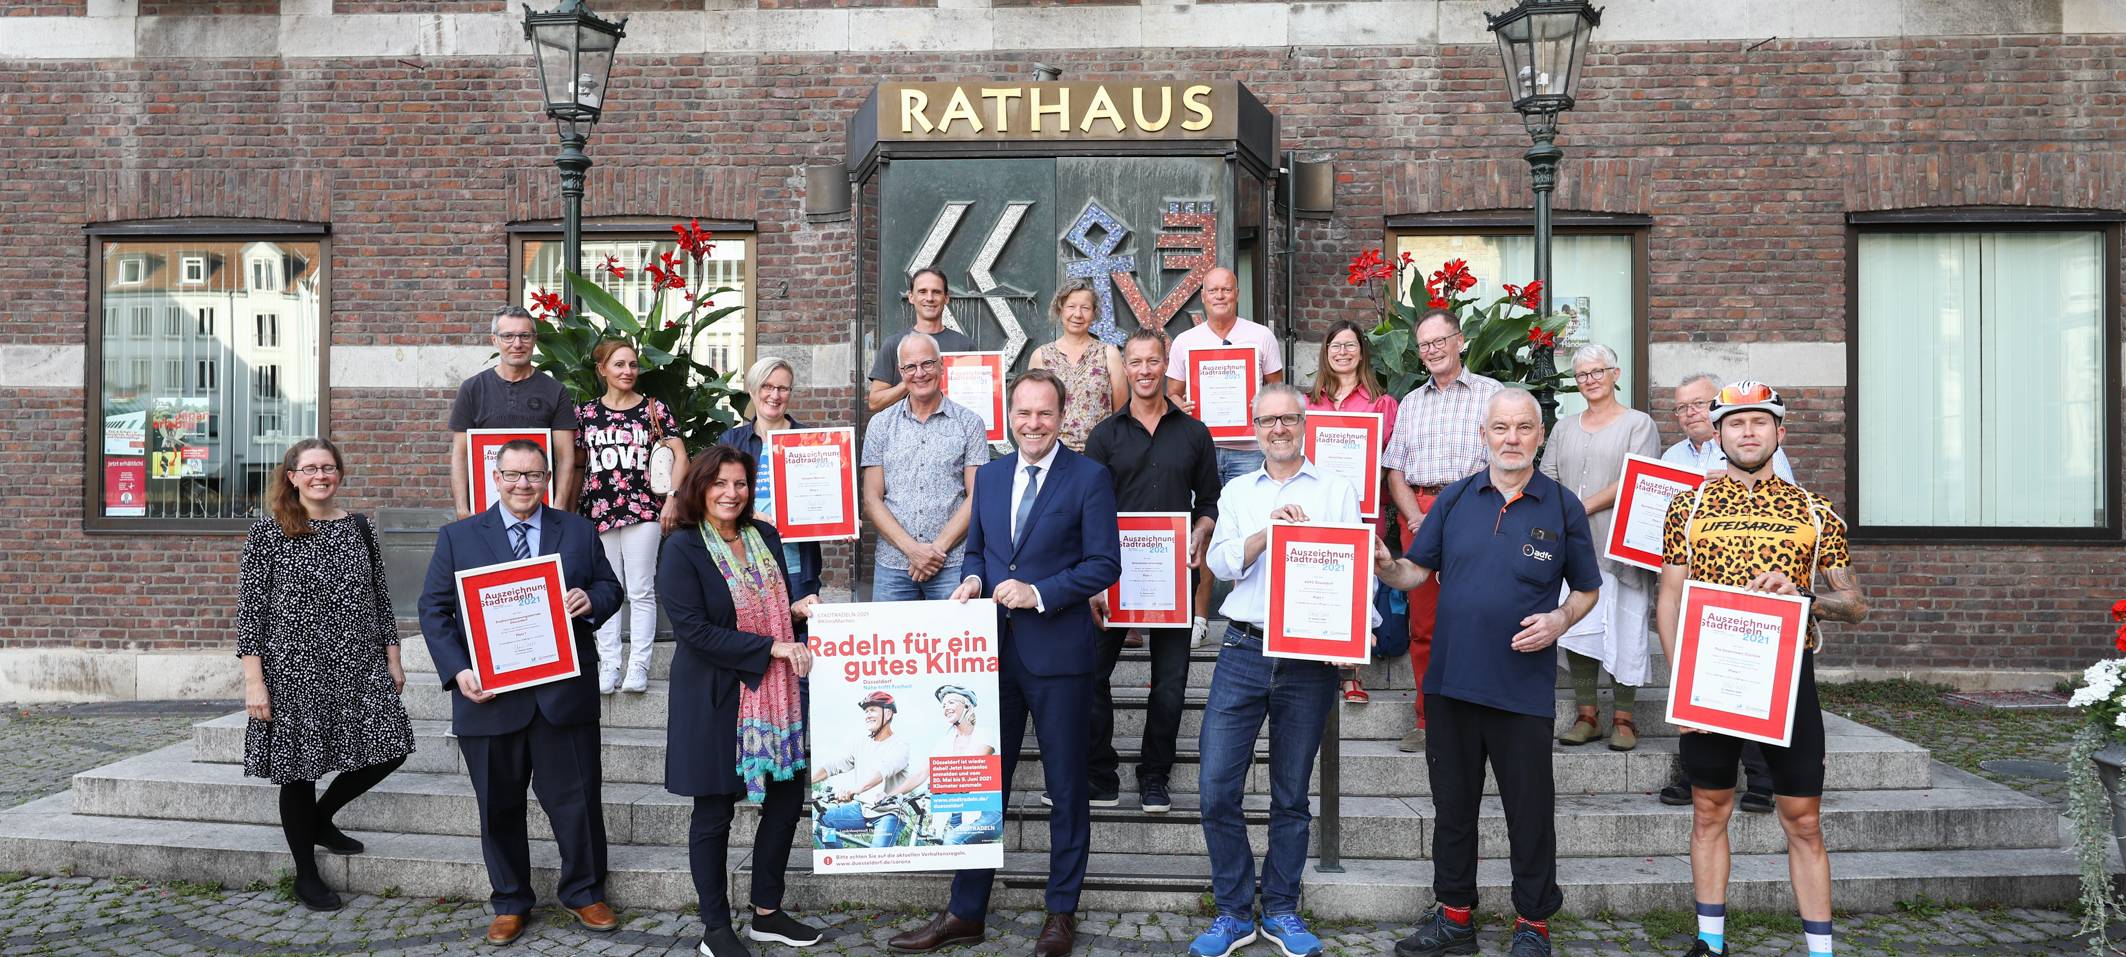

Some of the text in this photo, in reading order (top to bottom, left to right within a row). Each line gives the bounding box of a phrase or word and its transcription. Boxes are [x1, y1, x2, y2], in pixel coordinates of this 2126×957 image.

[900, 85, 1213, 134] RATHAUS
[779, 281, 789, 298] 2
[587, 428, 648, 447] FALL IN
[590, 446, 646, 473] LOVE
[1701, 521, 1799, 534] LIFEISARIDE
[1534, 550, 1552, 560] adfc
[1322, 564, 1344, 572] 2021
[518, 596, 540, 606] 2021
[808, 631, 987, 657] Radeln für ein
[1743, 633, 1769, 644] 2021
[844, 652, 999, 682] gutes Klima
